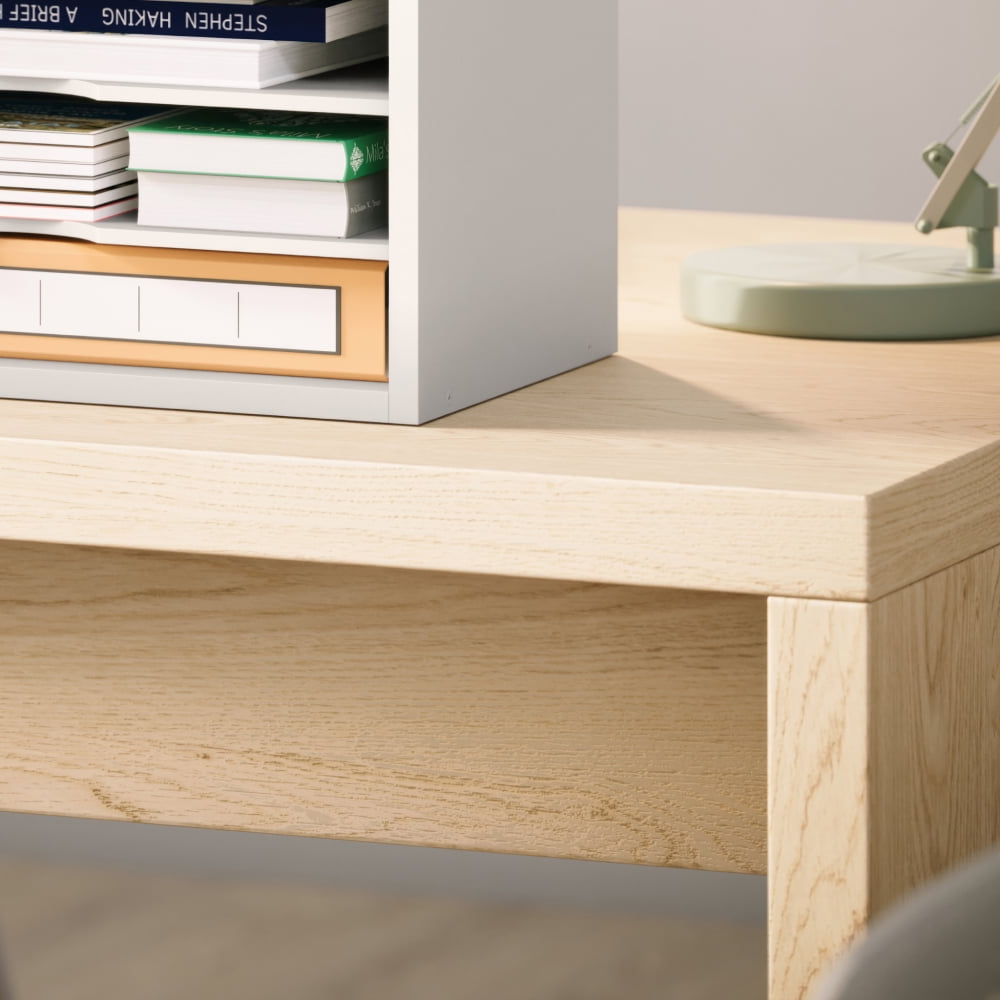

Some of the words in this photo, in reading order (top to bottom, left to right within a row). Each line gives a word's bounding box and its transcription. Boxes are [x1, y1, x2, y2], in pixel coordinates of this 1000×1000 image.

[9, 4, 59, 22] BRIEF
[66, 7, 77, 23] A
[103, 8, 171, 28] HAKING
[186, 12, 267, 32] STEPHEN
